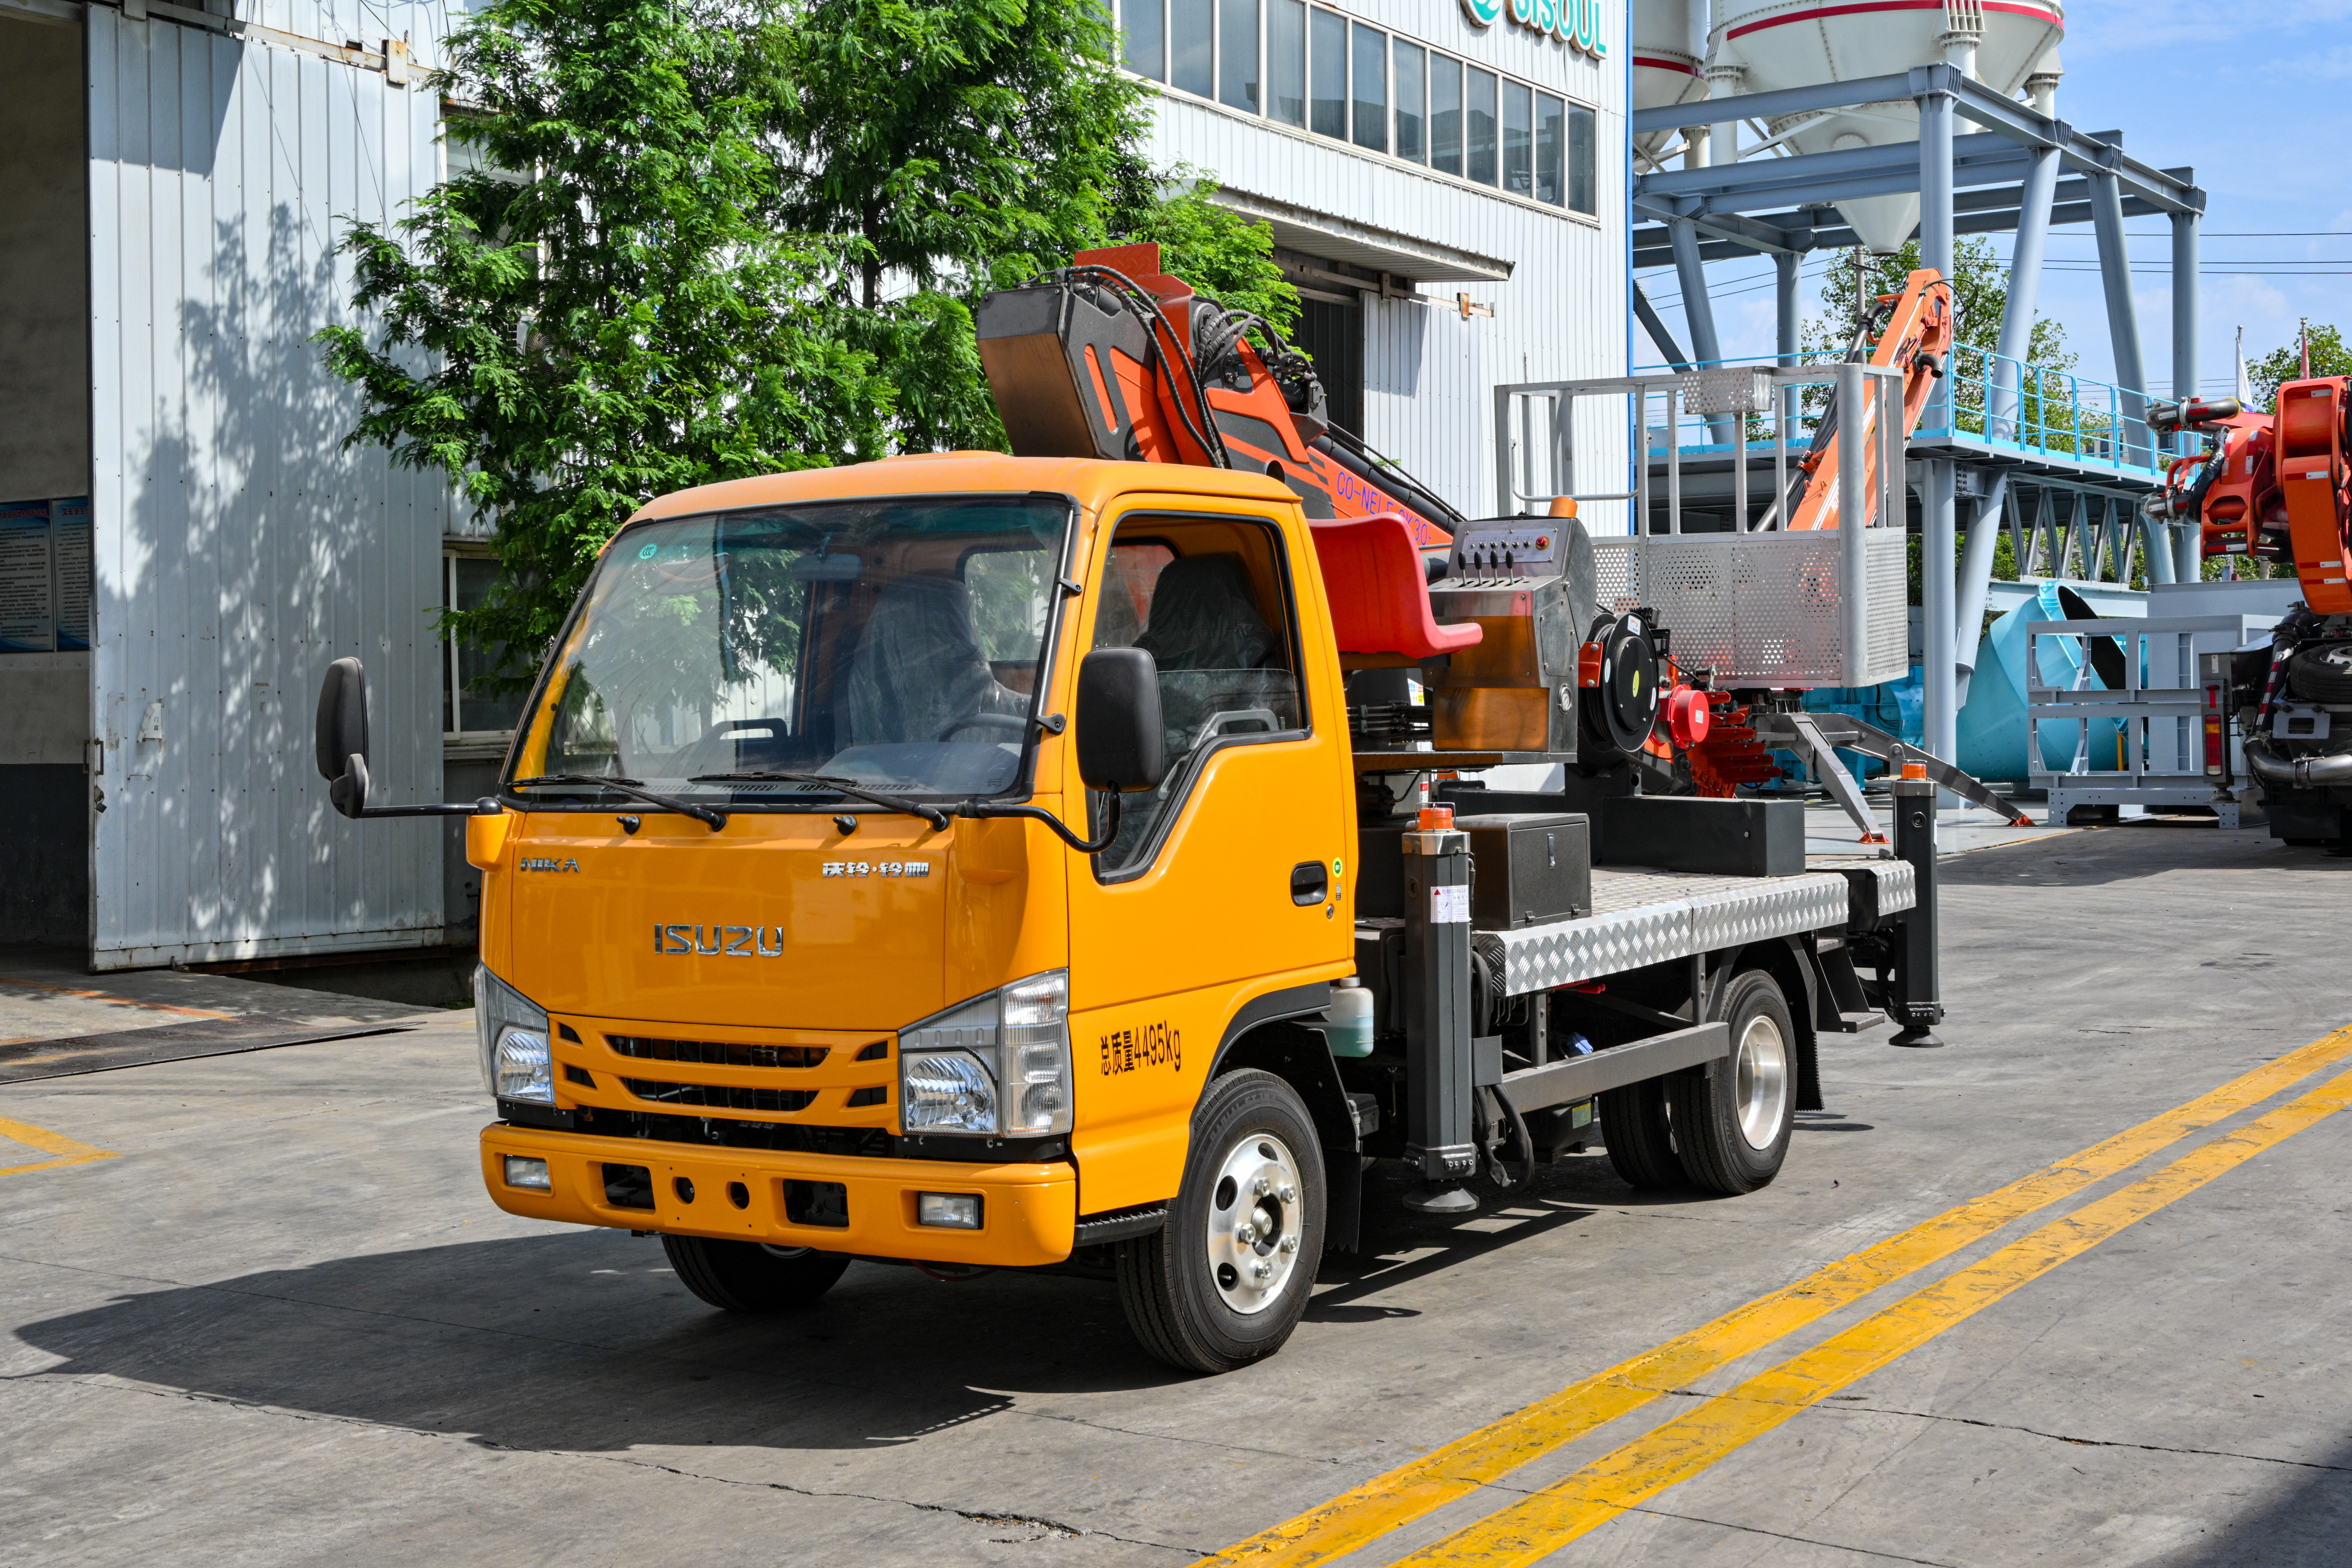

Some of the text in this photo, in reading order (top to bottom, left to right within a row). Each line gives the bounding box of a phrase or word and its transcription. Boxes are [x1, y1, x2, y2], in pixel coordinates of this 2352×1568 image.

[520, 858, 580, 872] NIKA
[654, 923, 784, 957] ISUZU
[1100, 1020, 1181, 1076] 总质量4495kg
